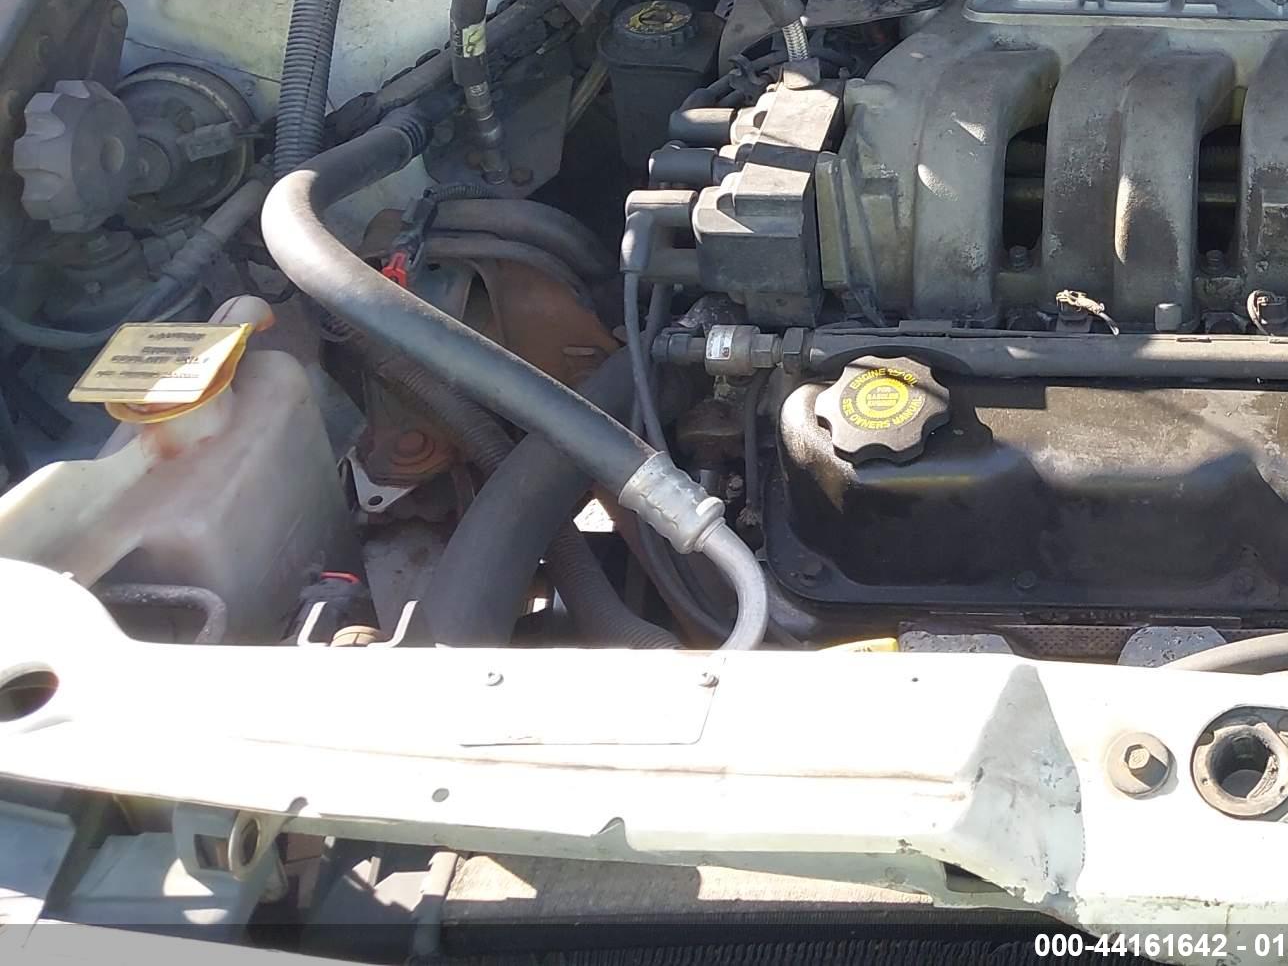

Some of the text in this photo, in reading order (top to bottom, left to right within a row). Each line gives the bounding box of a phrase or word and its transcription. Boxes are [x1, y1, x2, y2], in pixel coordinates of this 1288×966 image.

[850, 368, 919, 389] ENGINE OIL
[843, 398, 855, 416] SEE
[892, 395, 926, 425] MANUAL
